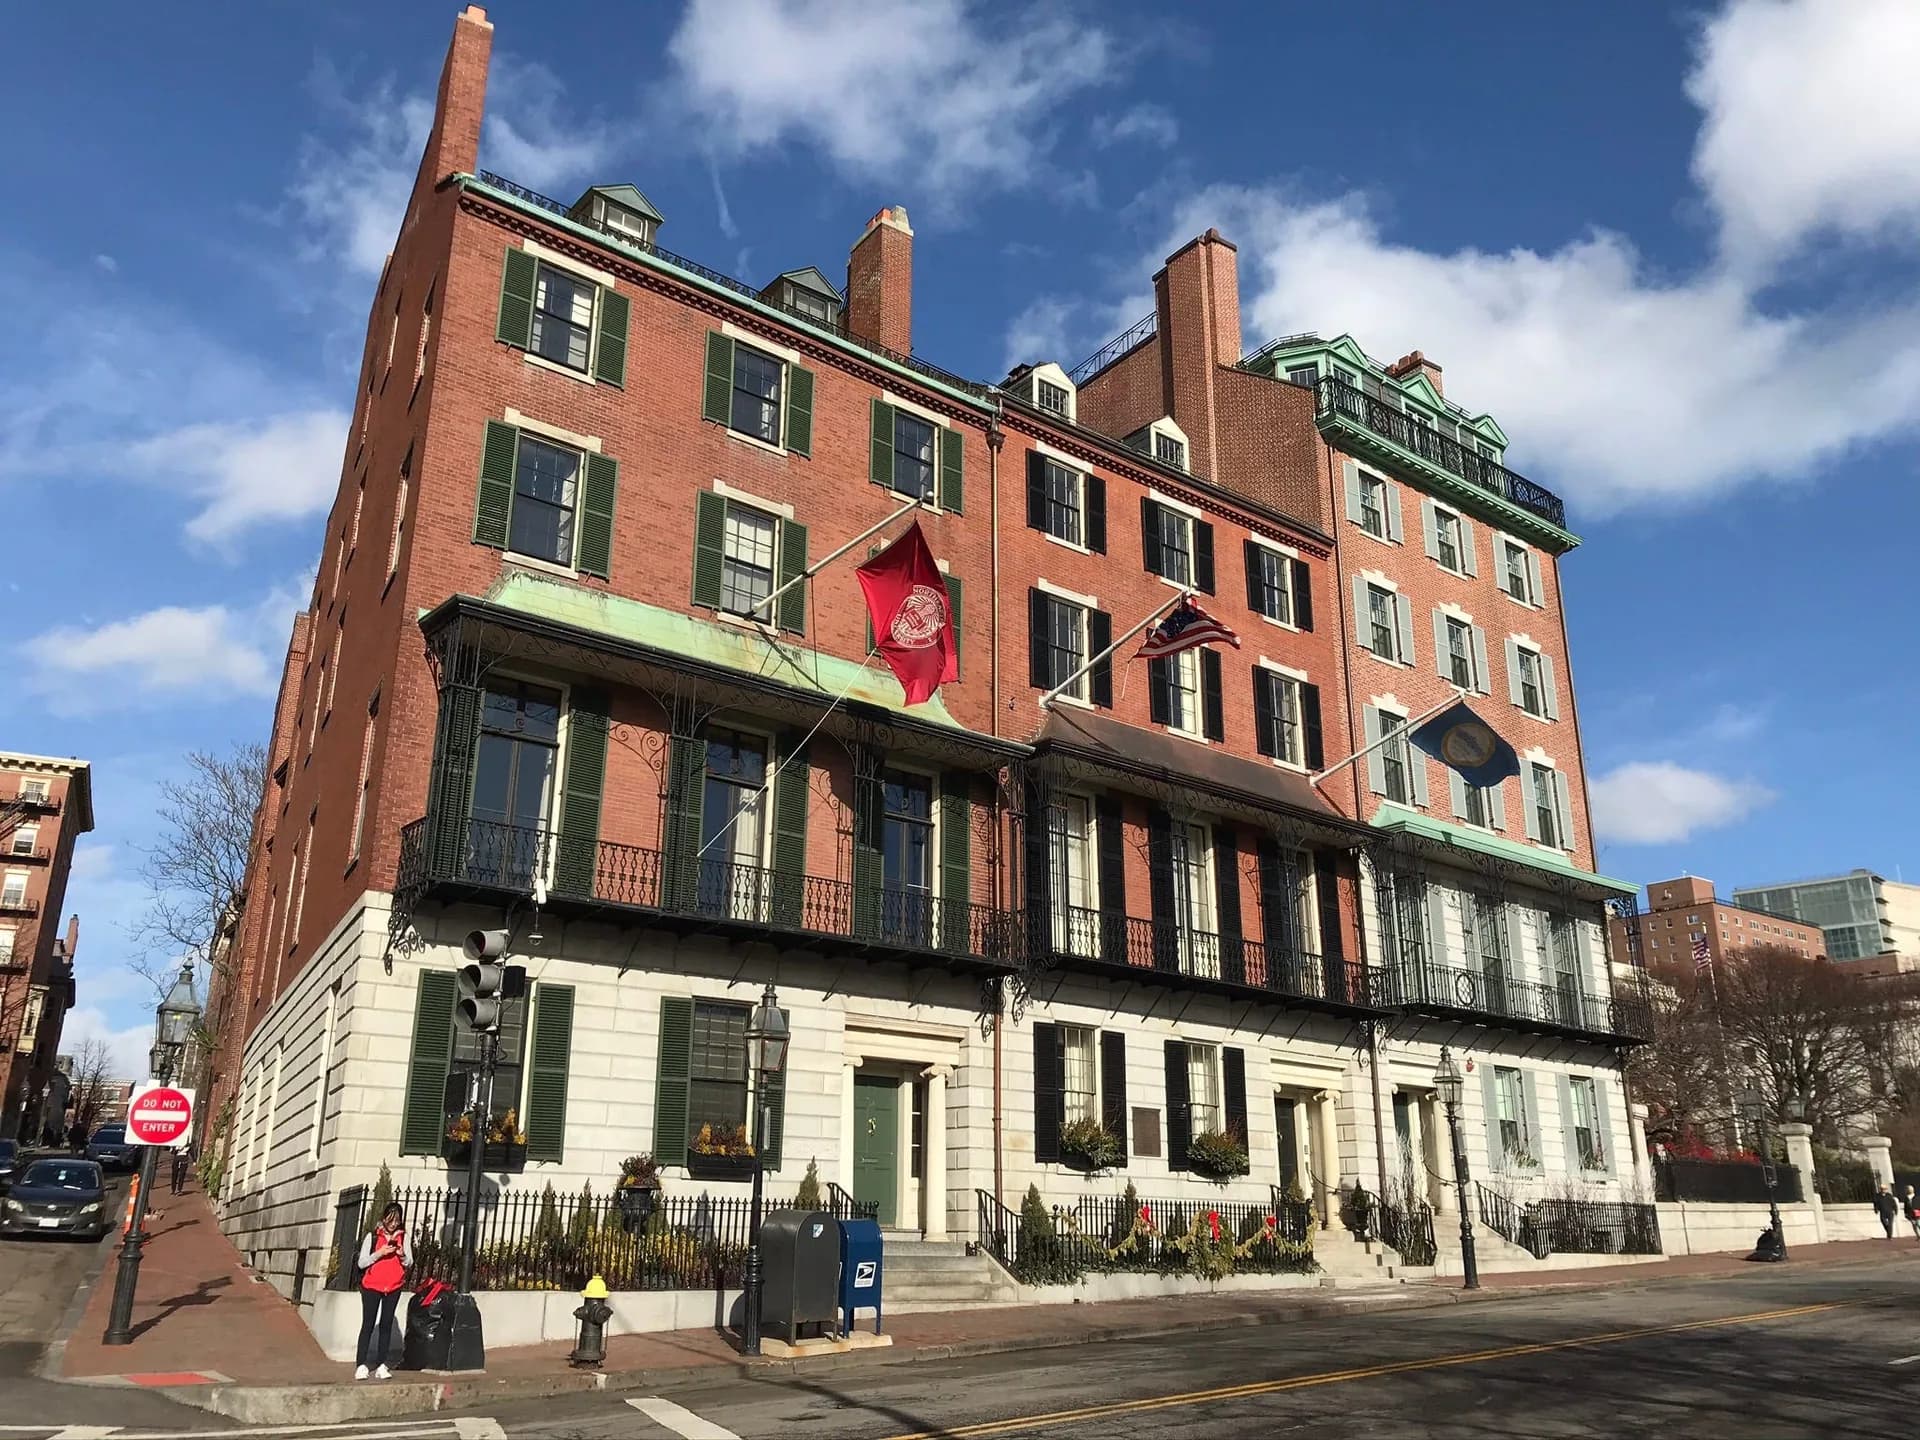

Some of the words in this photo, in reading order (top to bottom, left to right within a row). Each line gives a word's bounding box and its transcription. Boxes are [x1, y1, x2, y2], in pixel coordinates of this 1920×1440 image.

[143, 1099, 157, 1108] DO
[162, 1099, 182, 1109] NOT
[142, 1122, 176, 1133] ENTER
